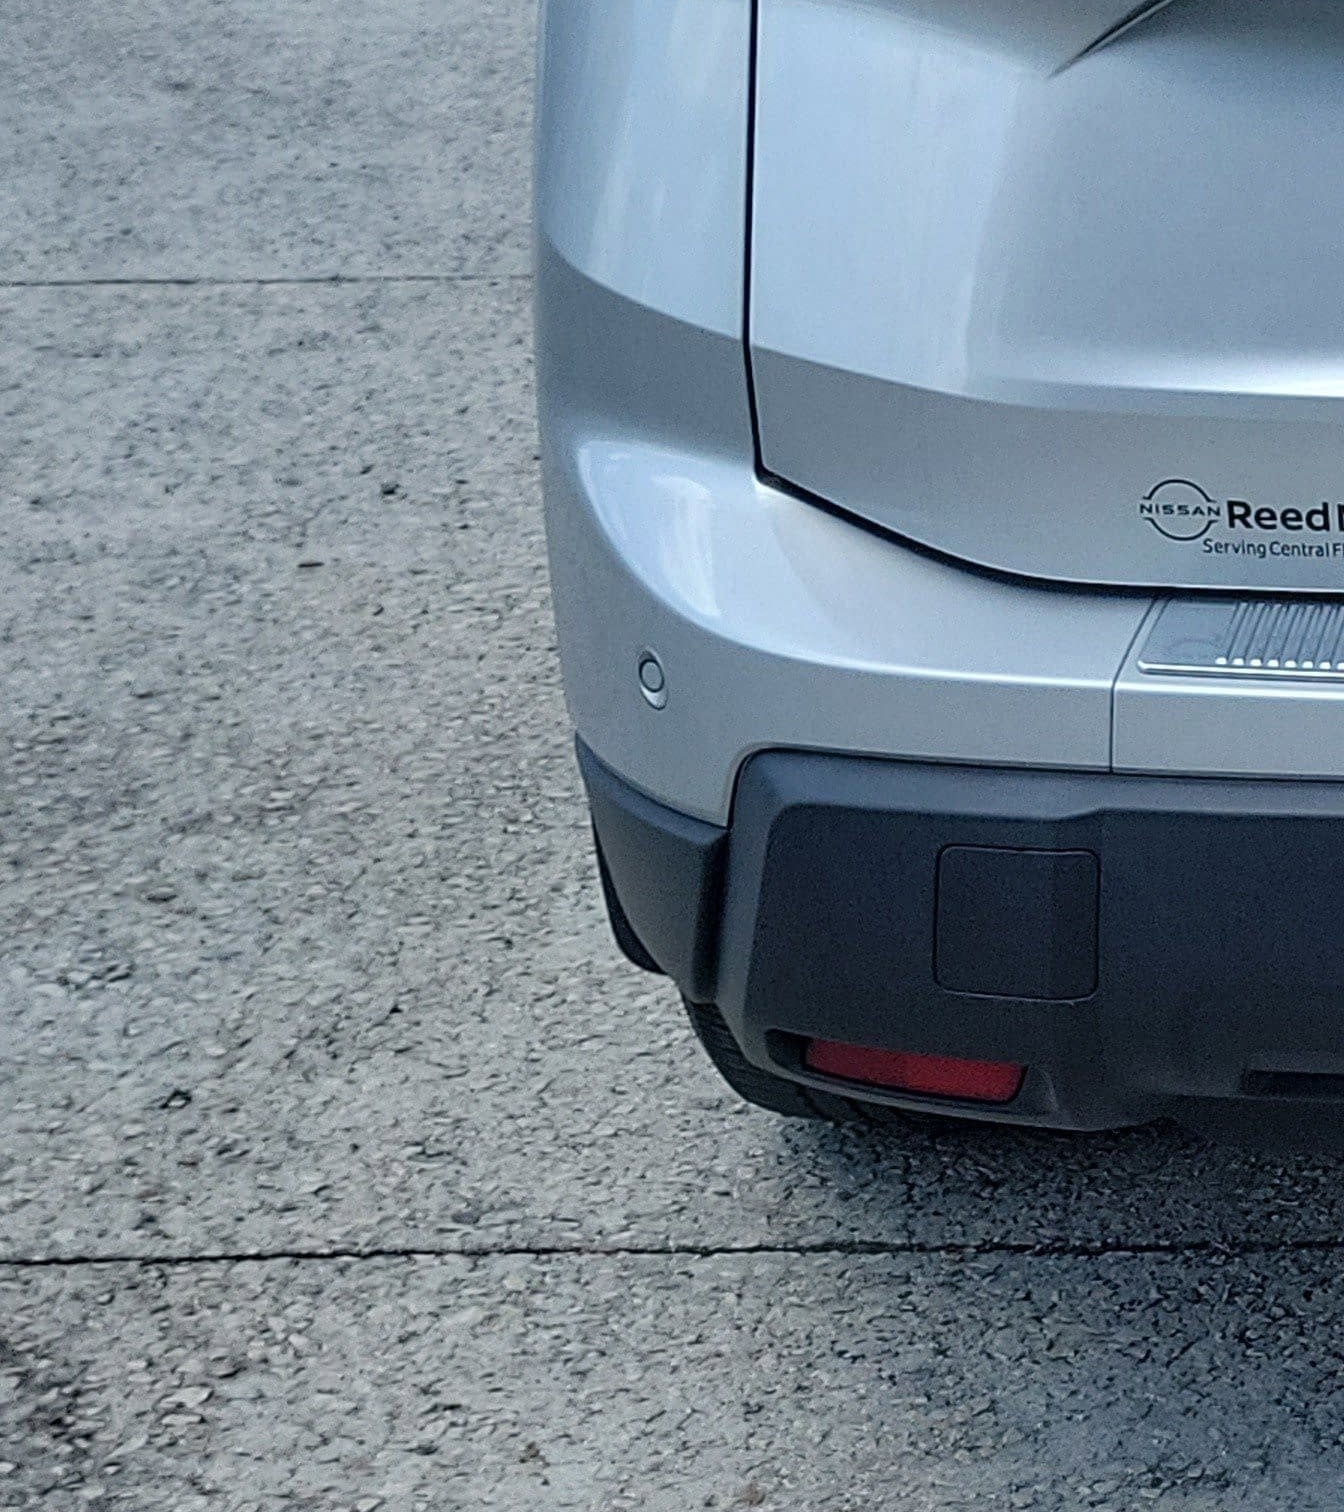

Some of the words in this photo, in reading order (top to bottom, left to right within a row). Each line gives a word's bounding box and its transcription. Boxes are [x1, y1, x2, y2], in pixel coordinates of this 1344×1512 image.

[1139, 503, 1221, 516] NISSAN
[1226, 500, 1330, 532] Reed
[1203, 539, 1266, 559] Serving
[1269, 541, 1329, 557] Central
